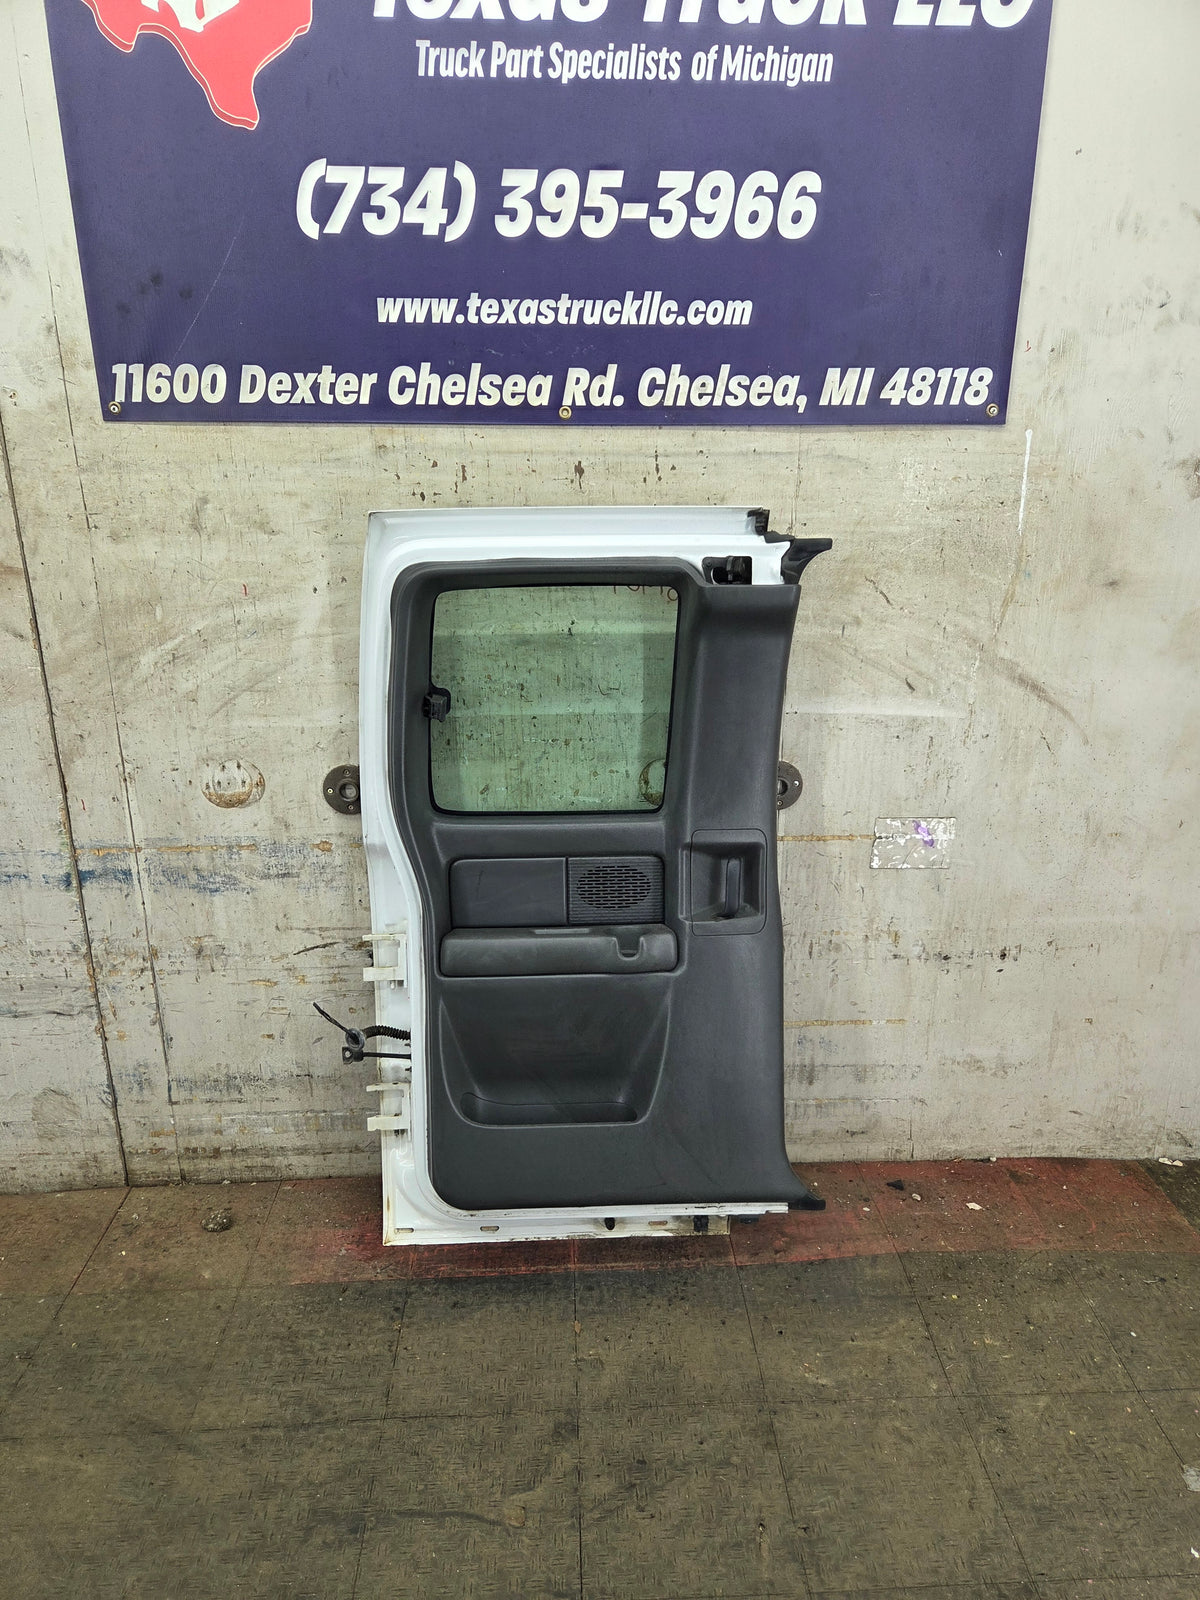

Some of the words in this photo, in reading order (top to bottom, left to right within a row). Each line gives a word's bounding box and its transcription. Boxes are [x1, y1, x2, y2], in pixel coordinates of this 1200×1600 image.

[415, 39, 486, 78] Truck
[489, 40, 545, 79] Part
[547, 42, 682, 85] Specialists
[690, 44, 719, 82] of
[720, 44, 834, 88] Michigan
[296, 157, 477, 243] (734)
[494, 168, 822, 240] 395-3966
[376, 290, 753, 326] www.texastruckllc.com
[111, 363, 227, 404] 11600
[238, 364, 378, 405] Dexter
[388, 362, 553, 407] Chelsea
[562, 363, 625, 407] Rd.
[637, 363, 808, 414] Chelsea,
[818, 367, 876, 407] MI
[879, 366, 994, 407] 48118
